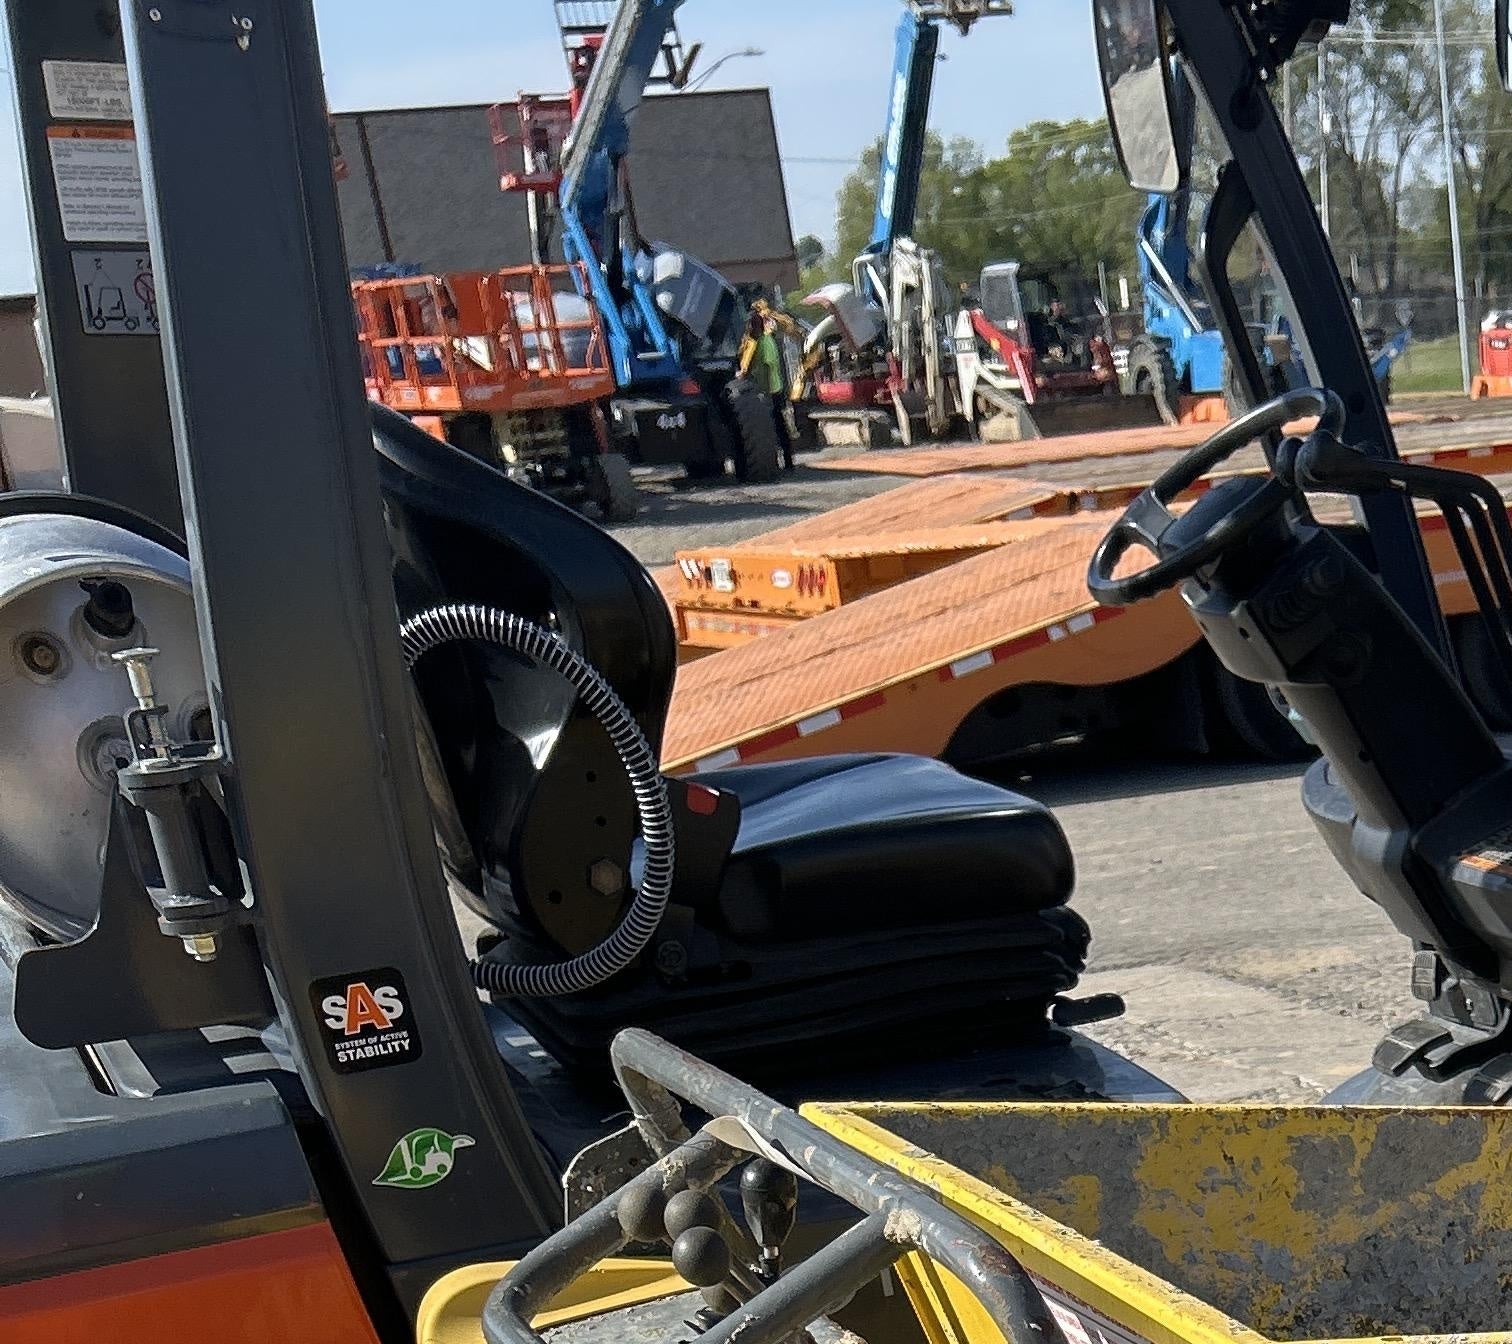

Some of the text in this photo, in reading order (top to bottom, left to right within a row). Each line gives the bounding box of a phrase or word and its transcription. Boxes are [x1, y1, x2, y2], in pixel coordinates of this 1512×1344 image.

[322, 982, 404, 1035] SAS
[335, 1030, 409, 1050] SYSTEM OF ACTIVE
[337, 1039, 411, 1062] STABILITY
